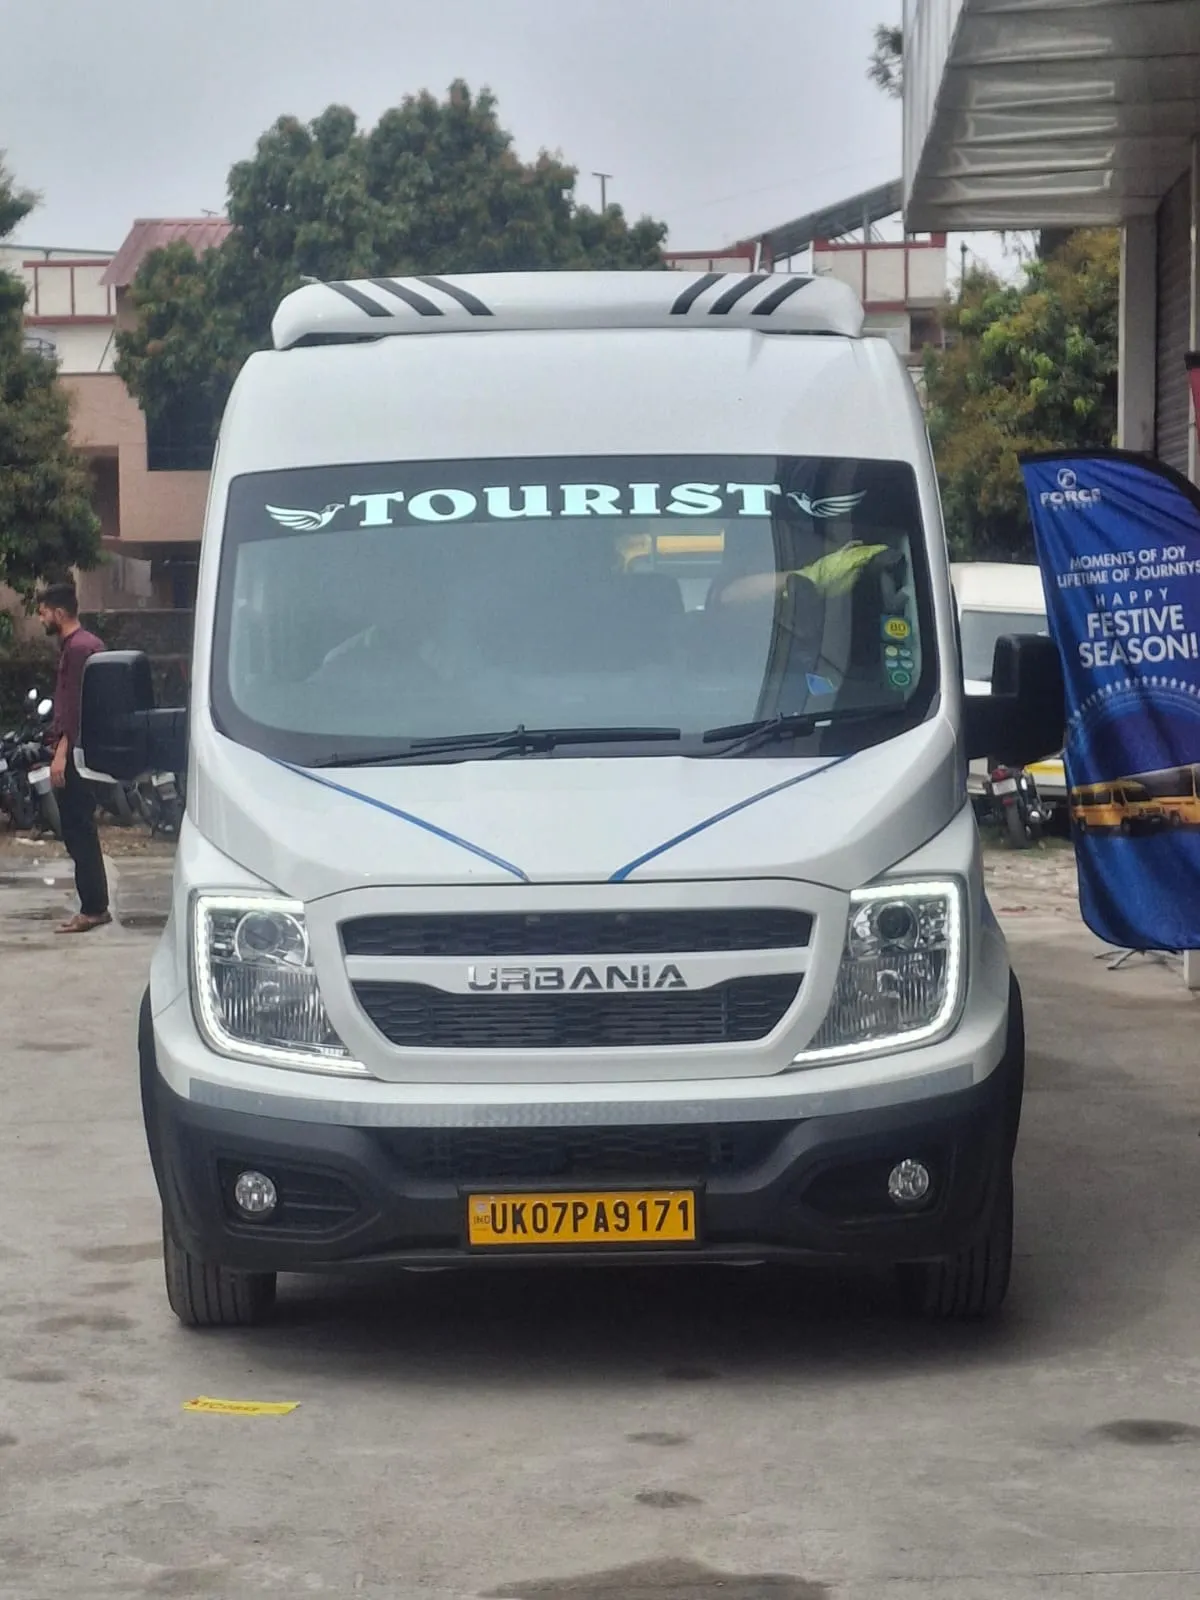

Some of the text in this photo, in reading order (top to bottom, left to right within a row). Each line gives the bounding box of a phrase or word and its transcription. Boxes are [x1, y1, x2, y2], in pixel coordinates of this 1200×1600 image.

[349, 482, 782, 527] TOURIST
[1070, 545, 1186, 571] MOMENTS OF JOY
[1057, 570, 1109, 588] LIFETIME
[1112, 567, 1129, 583] OF
[1096, 587, 1168, 607] HAPPY
[1087, 604, 1184, 638] FESTIVE
[1079, 632, 1198, 668] SEASON!
[490, 1200, 689, 1234] UK07PA9171
